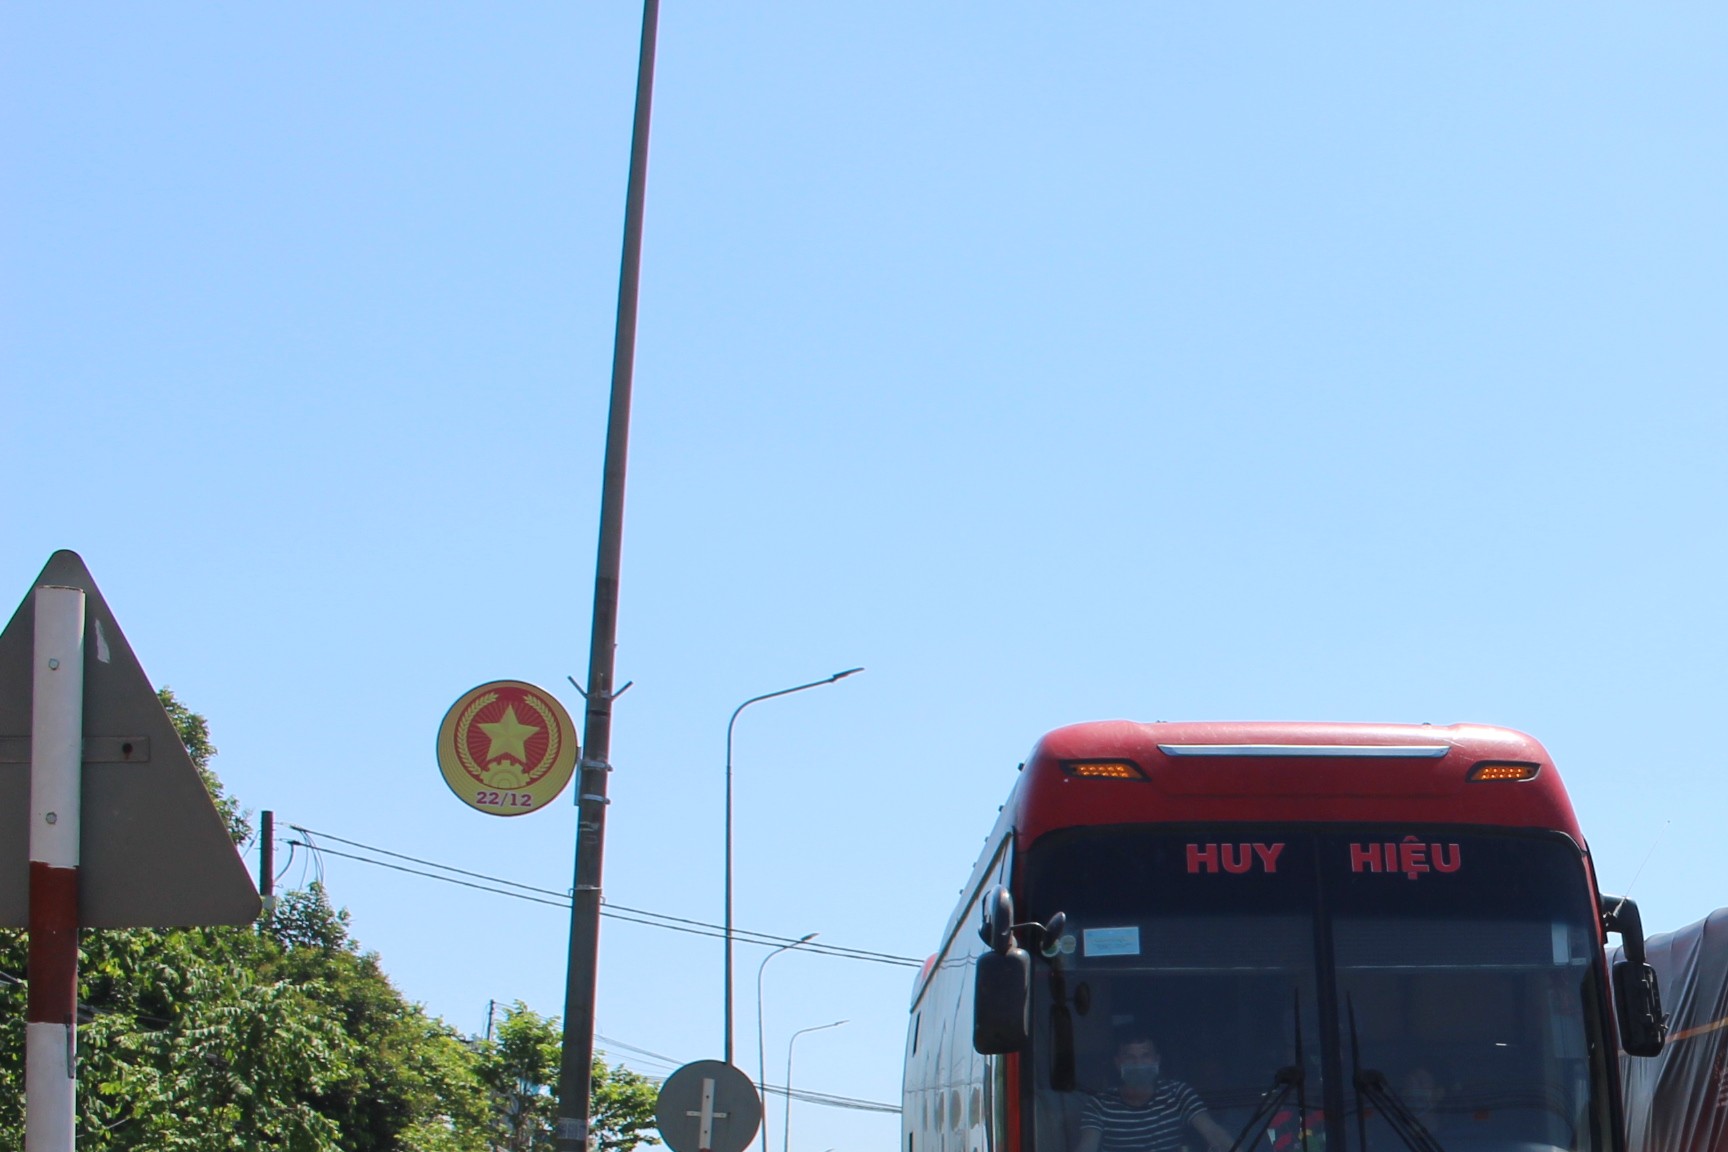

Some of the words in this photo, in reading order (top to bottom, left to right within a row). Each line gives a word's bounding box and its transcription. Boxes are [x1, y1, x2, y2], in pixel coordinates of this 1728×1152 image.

[476, 791, 532, 807] 22/12
[1186, 843, 1285, 874] HUY
[1350, 835, 1461, 880] HIỆU
